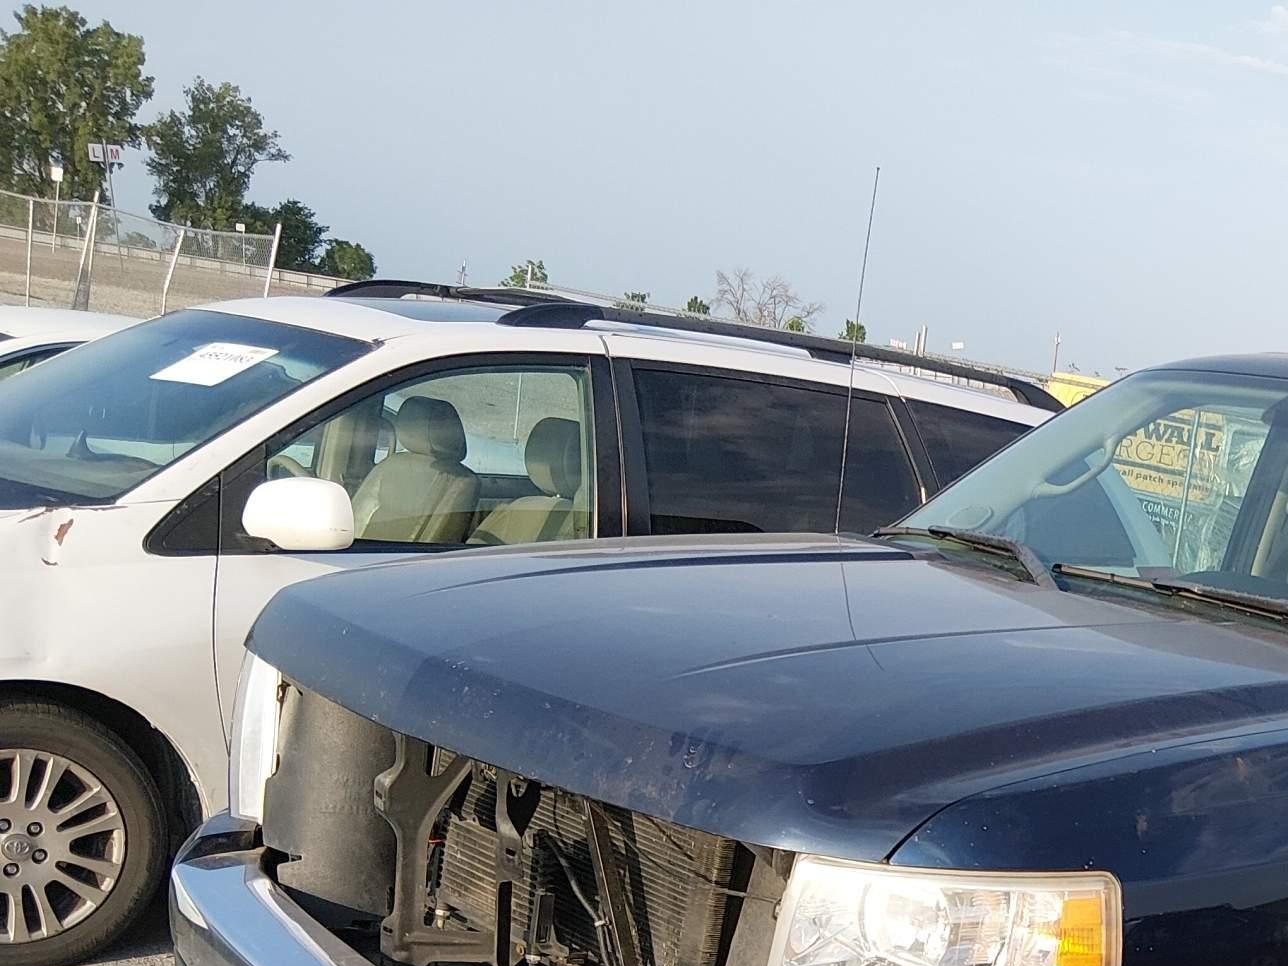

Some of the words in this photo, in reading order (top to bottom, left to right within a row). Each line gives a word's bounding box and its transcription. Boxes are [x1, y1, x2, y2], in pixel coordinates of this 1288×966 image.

[92, 146, 100, 158] L
[110, 148, 120, 160] M
[1142, 421, 1220, 452] WALL
[1120, 469, 1134, 478] all
[1135, 473, 1164, 485] patch
